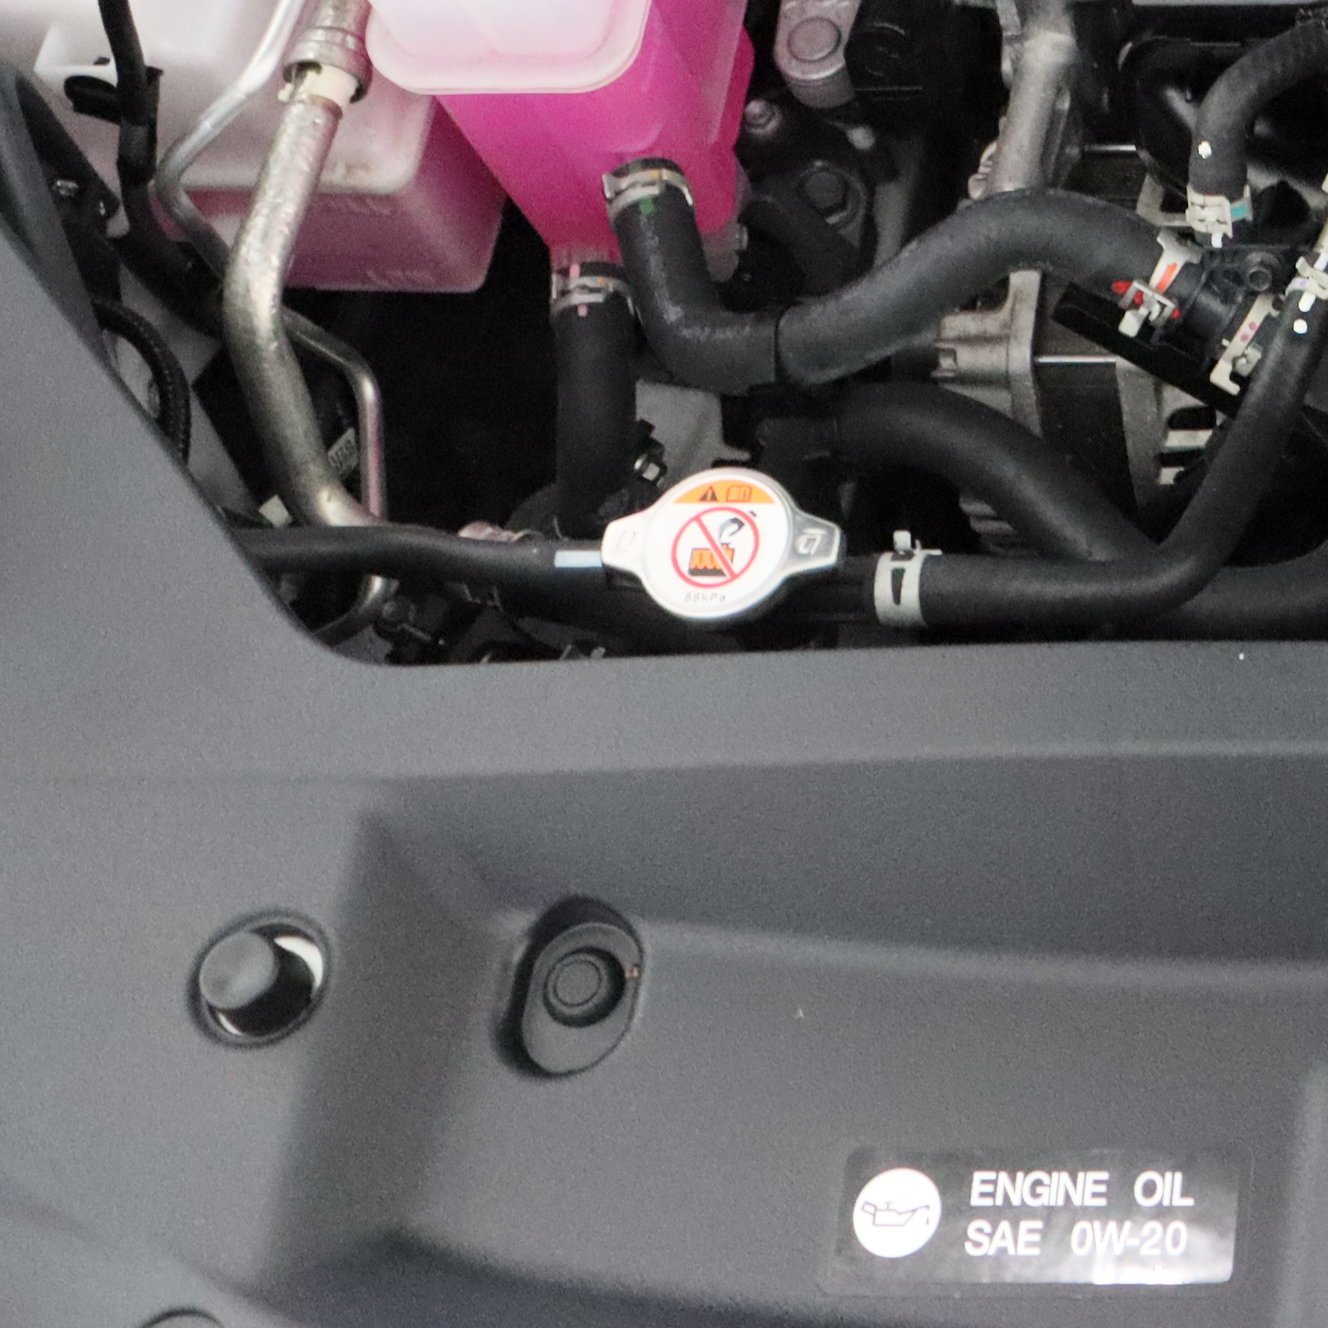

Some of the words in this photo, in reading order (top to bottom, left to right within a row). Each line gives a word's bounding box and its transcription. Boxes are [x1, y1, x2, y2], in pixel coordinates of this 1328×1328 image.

[969, 1170, 1110, 1207] ENGINE
[1133, 1170, 1196, 1207] OIL
[964, 1219, 1044, 1256] SAE
[1070, 1219, 1188, 1256] 0W-20
